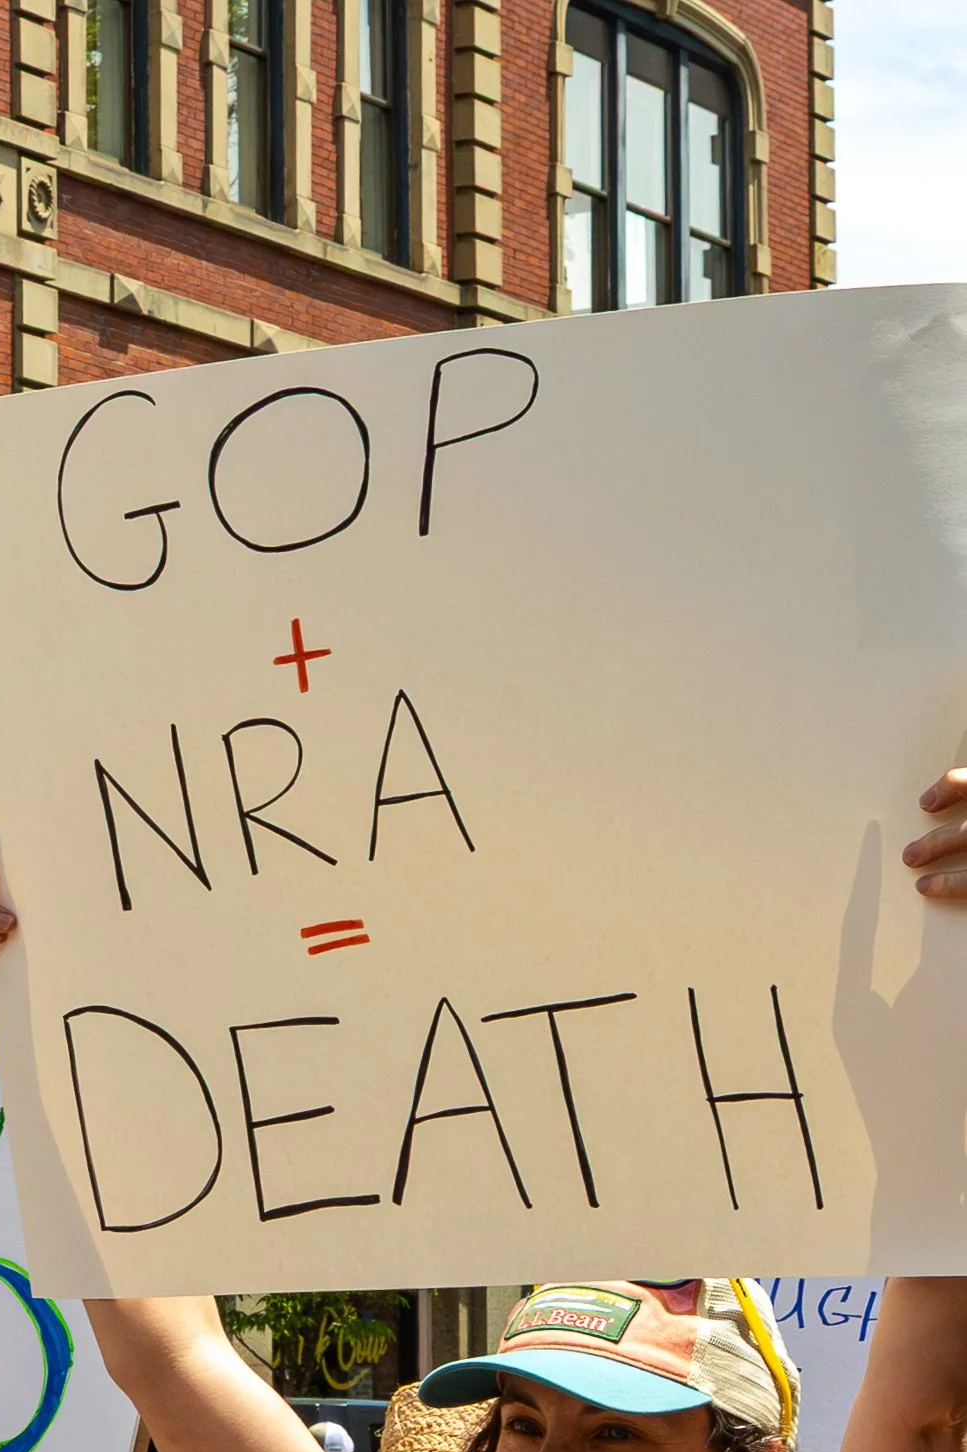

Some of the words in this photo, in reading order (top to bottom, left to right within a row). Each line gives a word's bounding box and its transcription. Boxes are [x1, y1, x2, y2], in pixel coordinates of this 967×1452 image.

[57, 346, 539, 591] GOP
[95, 688, 475, 911] NRA
[63, 985, 825, 1233] DEATH
